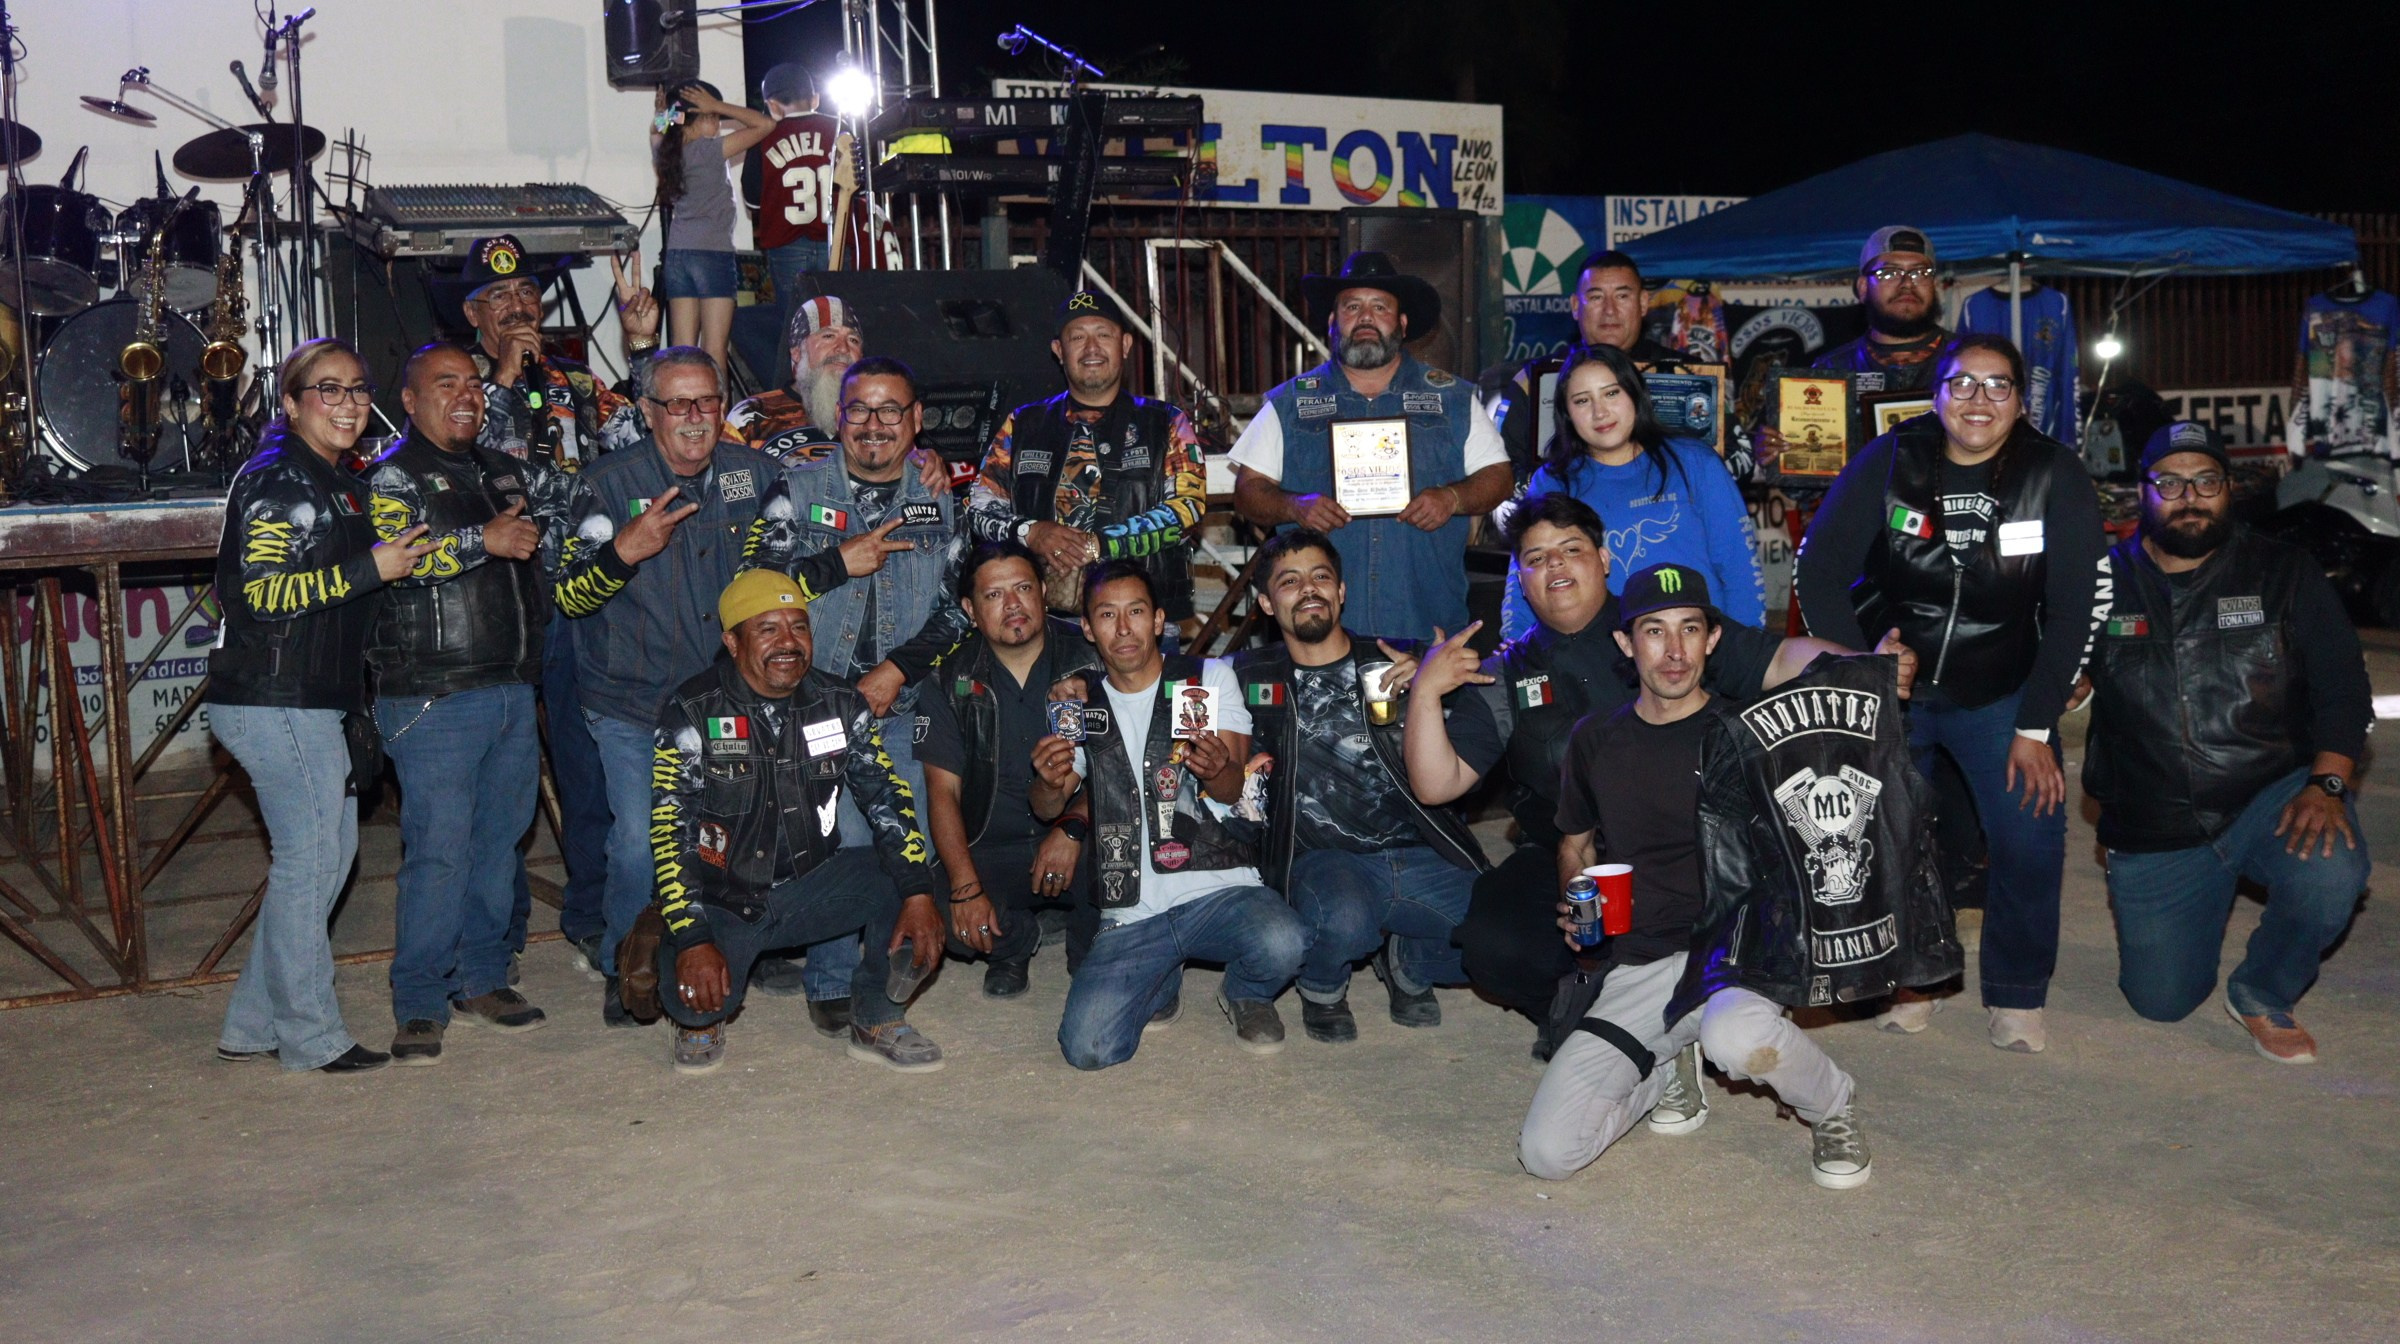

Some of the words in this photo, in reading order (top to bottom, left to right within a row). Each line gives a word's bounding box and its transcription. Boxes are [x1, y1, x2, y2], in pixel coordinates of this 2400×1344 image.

[765, 132, 824, 169] URIEL
[1460, 138, 1493, 162] NVO.
[1014, 123, 1459, 207] LTON
[1454, 161, 1498, 183] LEON
[482, 238, 499, 264] PEACE
[1505, 300, 1571, 314] INSTALACIO
[1734, 314, 1773, 348] OSOS
[1299, 397, 1335, 407] PERALTA
[1020, 462, 1049, 471] TESORERO
[720, 471, 751, 487] NOVATOS
[723, 484, 753, 500] JACKSON
[904, 506, 938, 519] NOVATOS
[906, 515, 941, 526] Sergio
[245, 518, 294, 564] MX
[2220, 600, 2258, 610] NOVATOS
[1515, 674, 1549, 689] MÉXICO
[1753, 690, 1876, 742] NOVATOS
[651, 747, 694, 791] MX
[1813, 790, 1852, 822] MC
[650, 801, 696, 936] TIJUANA
